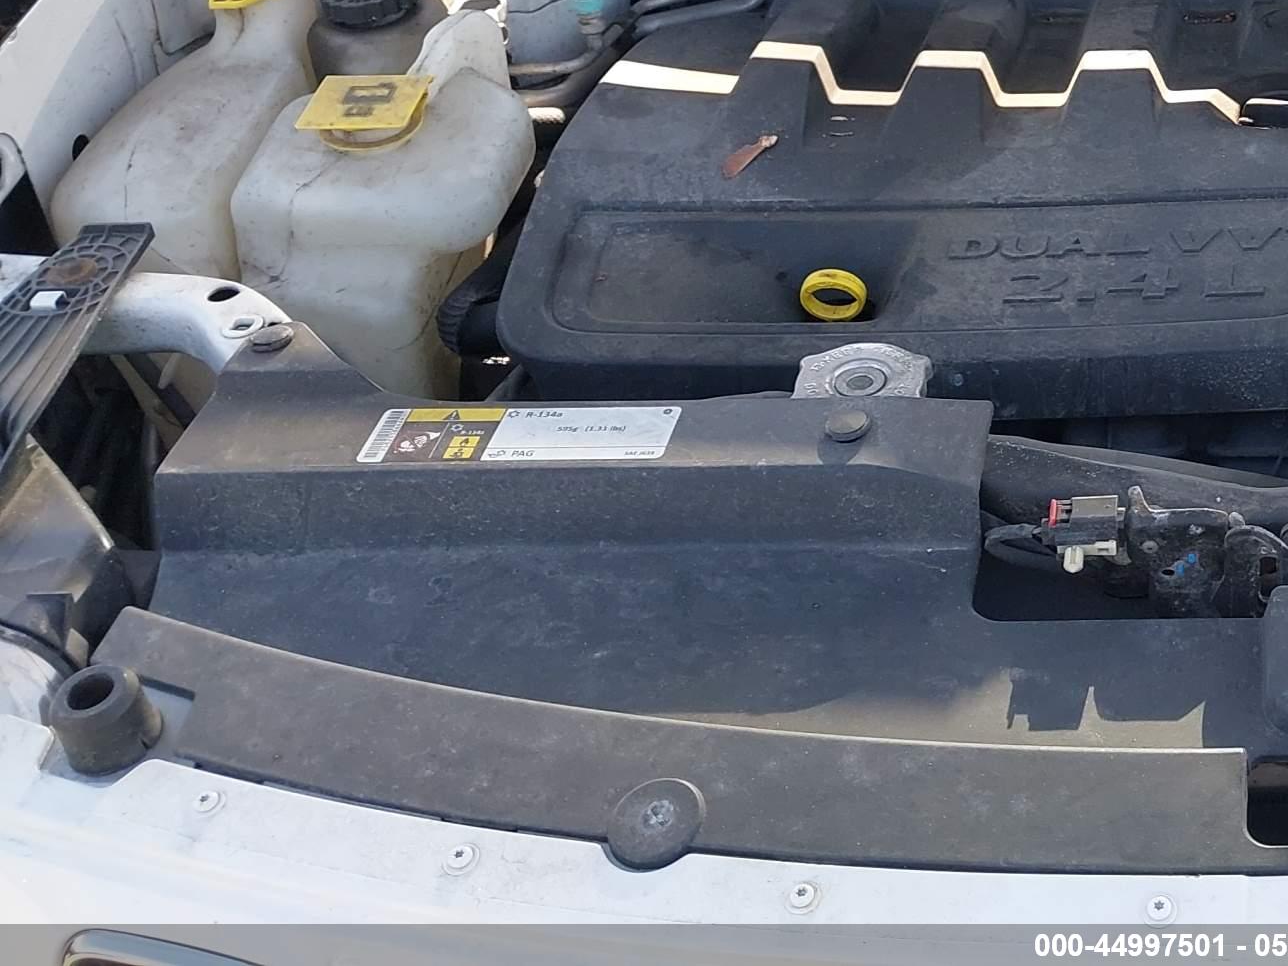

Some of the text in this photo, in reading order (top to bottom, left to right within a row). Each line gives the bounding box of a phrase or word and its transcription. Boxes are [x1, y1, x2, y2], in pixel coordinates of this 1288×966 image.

[948, 231, 1151, 261] DUAL
[524, 410, 564, 419] R-134a
[511, 449, 535, 457] PAG
